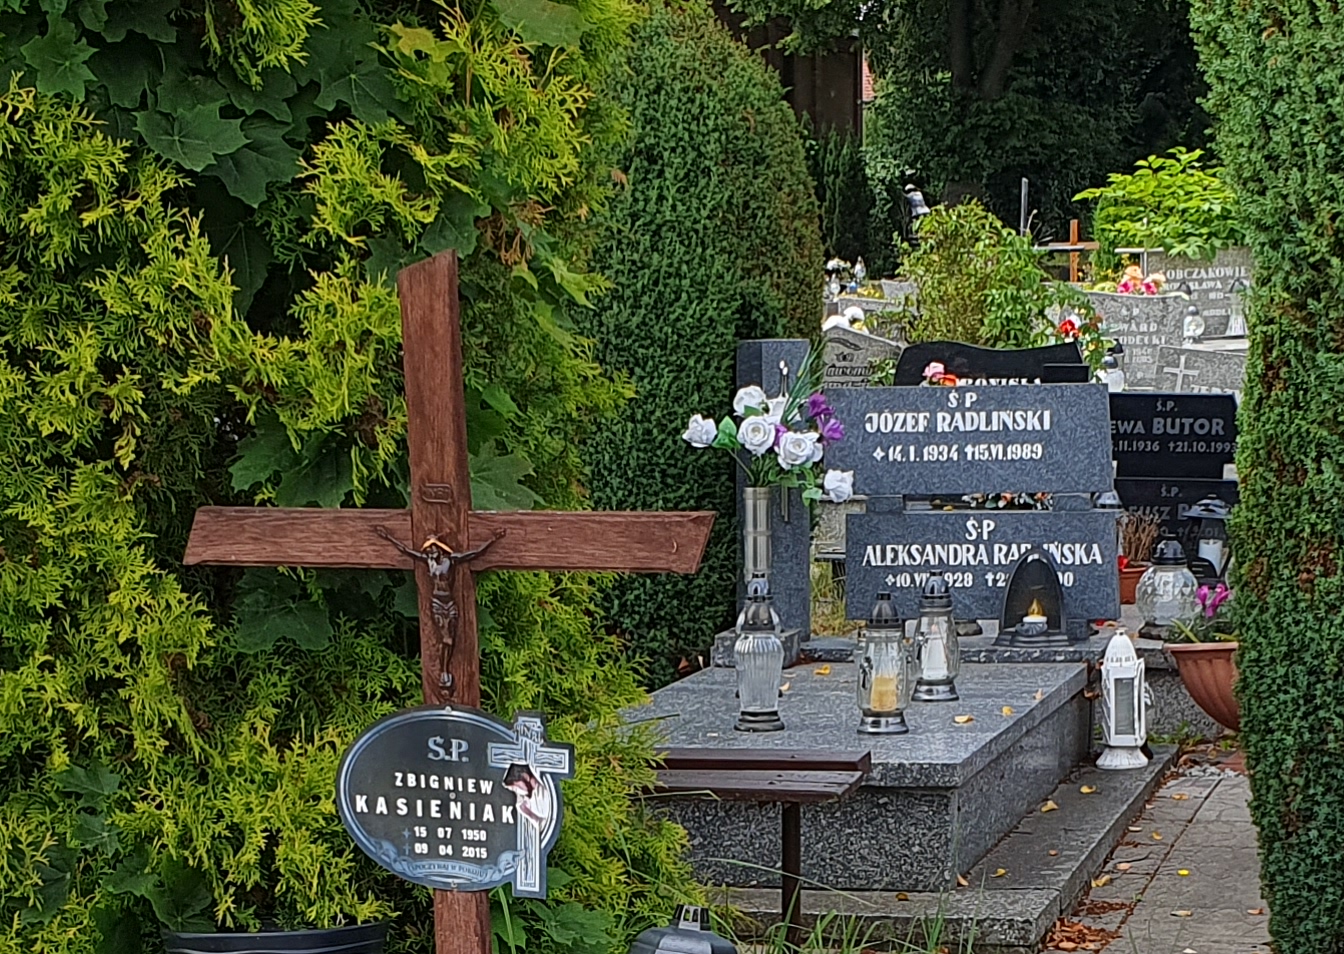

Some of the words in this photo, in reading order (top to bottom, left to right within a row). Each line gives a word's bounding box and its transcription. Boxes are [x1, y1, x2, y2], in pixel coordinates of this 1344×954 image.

[1166, 266, 1248, 280] OBCZAKOWIE
[1120, 322, 1159, 333] WARD
[864, 409, 930, 434] JÓZEF
[936, 408, 1052, 434] RADLIŃSKI
[1152, 418, 1225, 436] BUTOR
[1111, 440, 1160, 452] .11.1936
[862, 543, 989, 567] ALEKSANDRA
[394, 772, 494, 795] ZBIGNIEW
[355, 794, 515, 825] KASIENIAK
[414, 826, 427, 838] 15
[437, 827, 452, 839] 07
[461, 828, 487, 841] 1950
[414, 843, 428, 854] 09
[439, 844, 453, 856] 04
[462, 846, 488, 859] 2015
